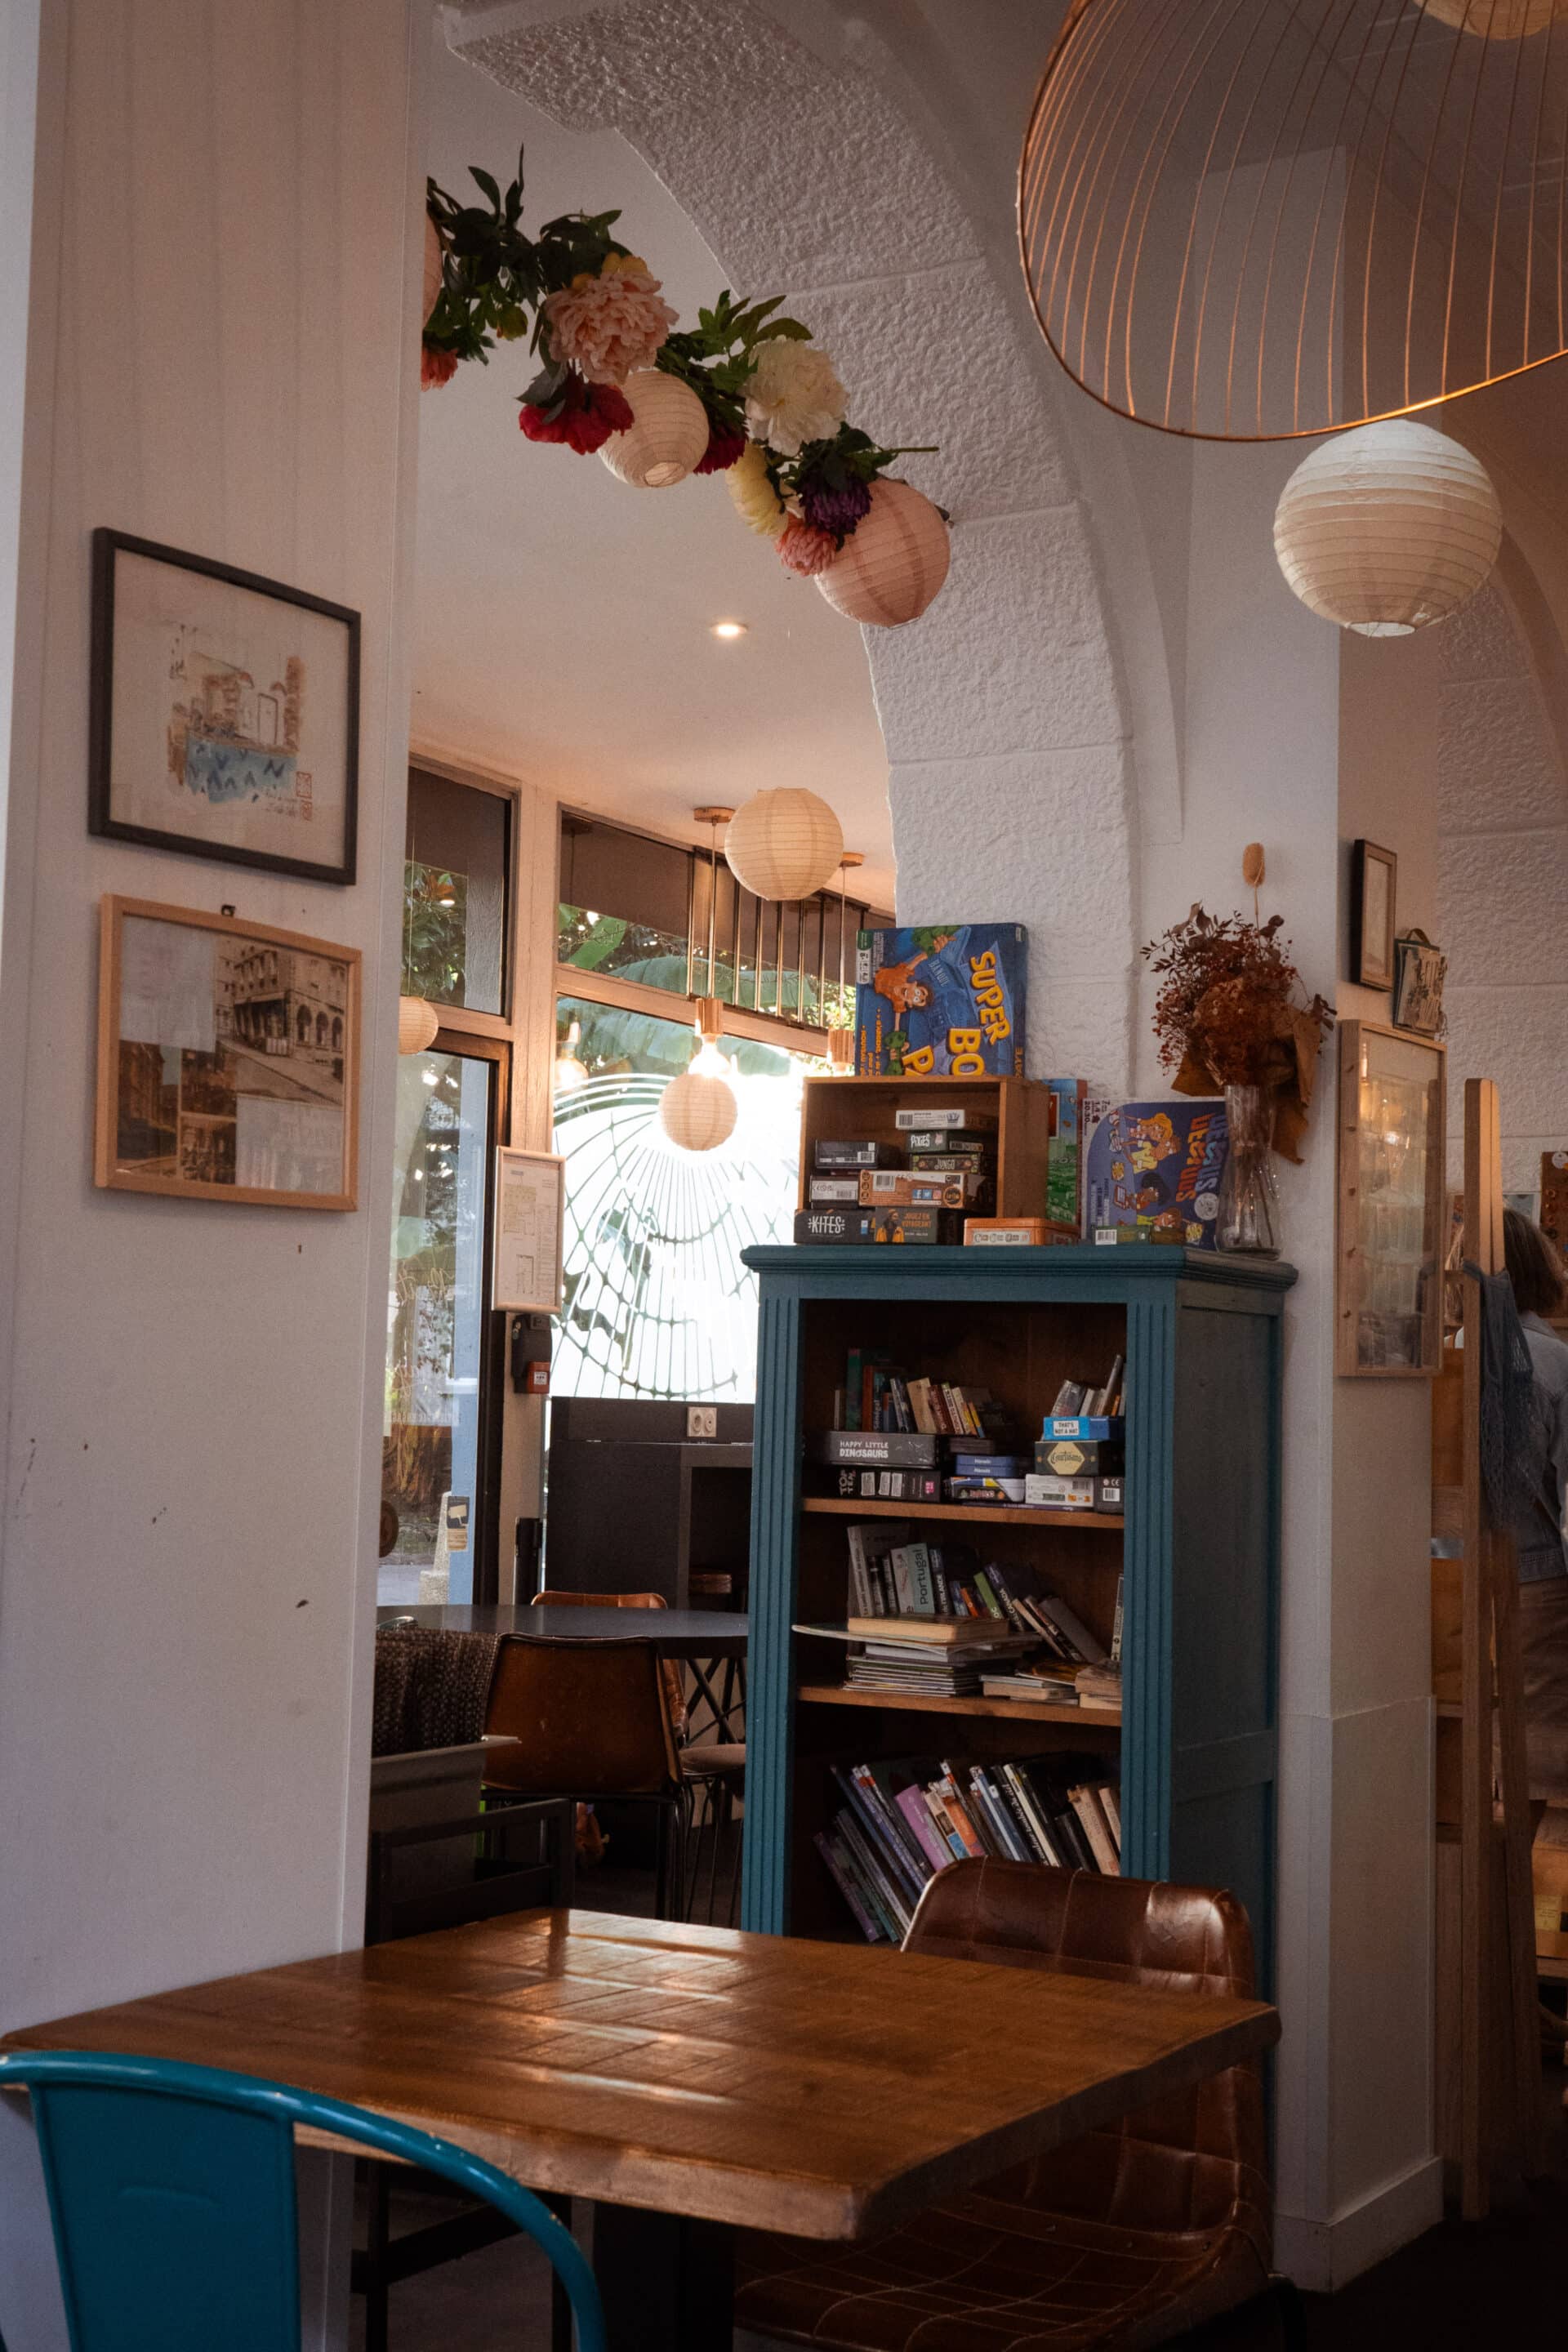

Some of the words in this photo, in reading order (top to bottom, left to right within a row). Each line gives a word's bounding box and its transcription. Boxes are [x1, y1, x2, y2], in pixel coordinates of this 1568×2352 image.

[928, 959, 948, 988] BANQUE
[969, 951, 1011, 1045] SUPER
[911, 1133, 931, 1150] PIXIES
[812, 1216, 842, 1234] KITES
[840, 1449, 889, 1459] DINOSAURS
[913, 1548, 928, 1605] Portugal
